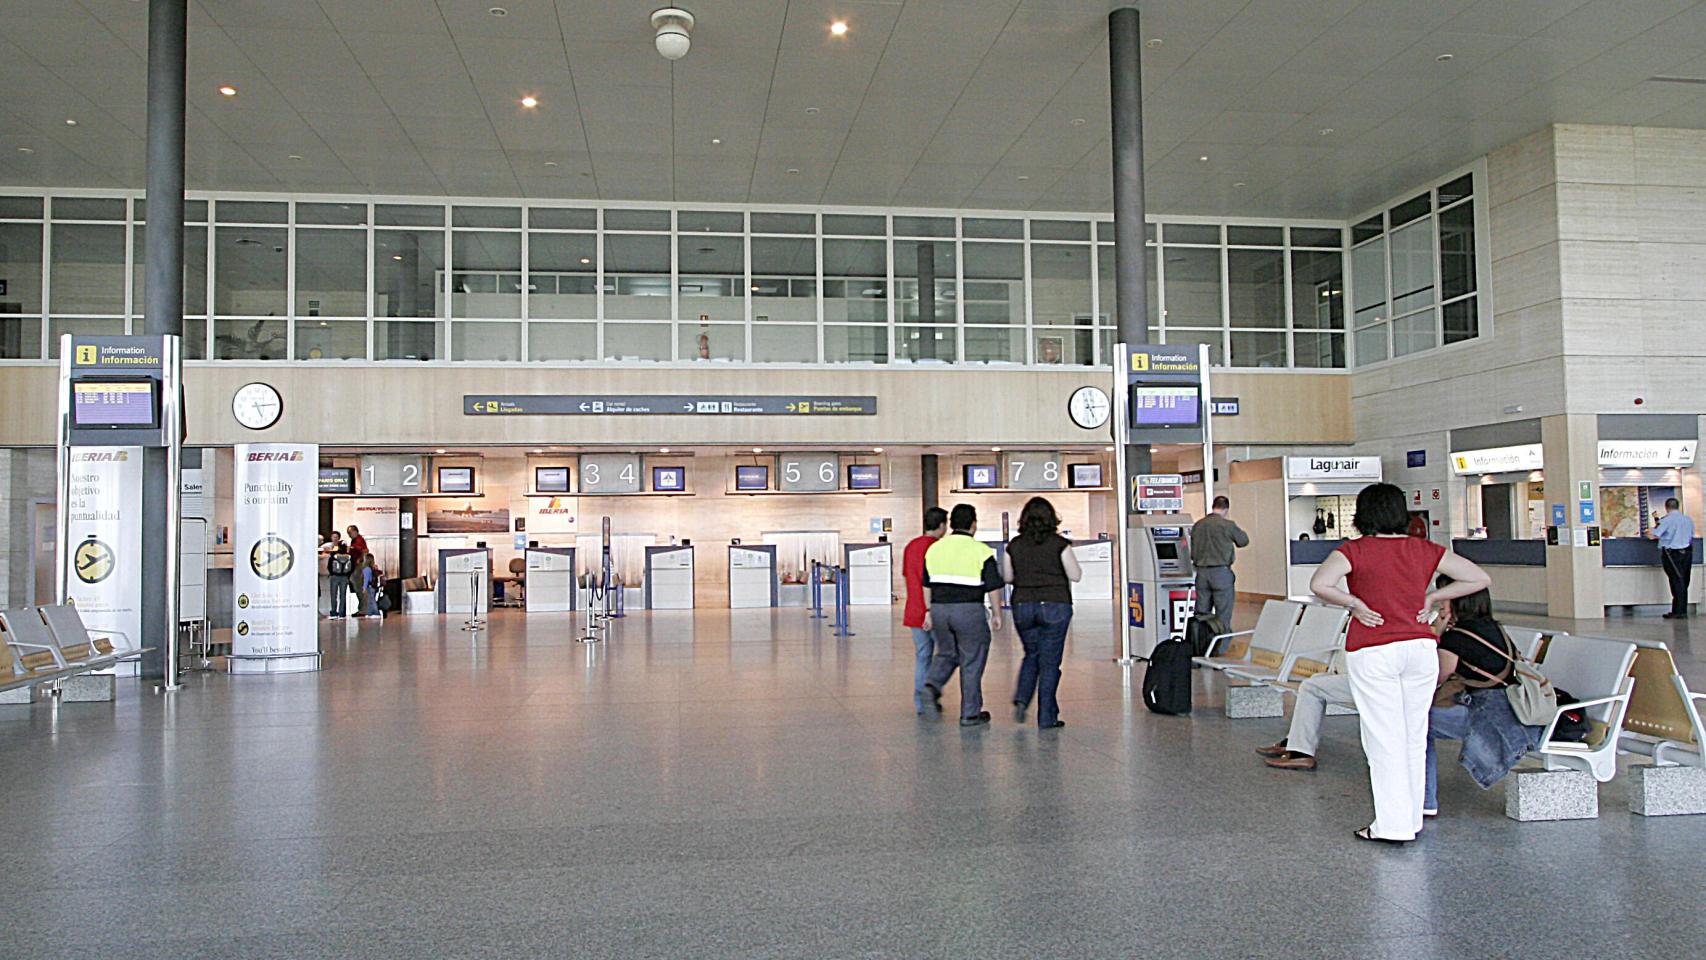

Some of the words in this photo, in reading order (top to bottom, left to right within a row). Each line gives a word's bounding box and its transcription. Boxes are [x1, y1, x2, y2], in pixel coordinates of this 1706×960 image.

[101, 346, 145, 354] Information
[101, 356, 159, 364] Información
[71, 452, 113, 462] IBERIA
[245, 452, 289, 462] IBERIA
[1600, 448, 1658, 459] Información
[1310, 458, 1360, 472] Lagunair
[1473, 455, 1520, 465] Información
[364, 464, 376, 486] 1
[402, 464, 419, 486] 2
[585, 463, 600, 485] 3
[619, 463, 636, 484] 4
[785, 462, 800, 482] 5
[819, 462, 834, 482] 6
[1011, 461, 1025, 482] 7
[1043, 461, 1058, 481] 8
[71, 473, 100, 482] Nuestro
[71, 485, 101, 496] objetivo
[244, 482, 293, 494] Punctuality
[79, 498, 86, 508] la
[244, 496, 250, 504] is
[71, 510, 121, 524] puntualidad
